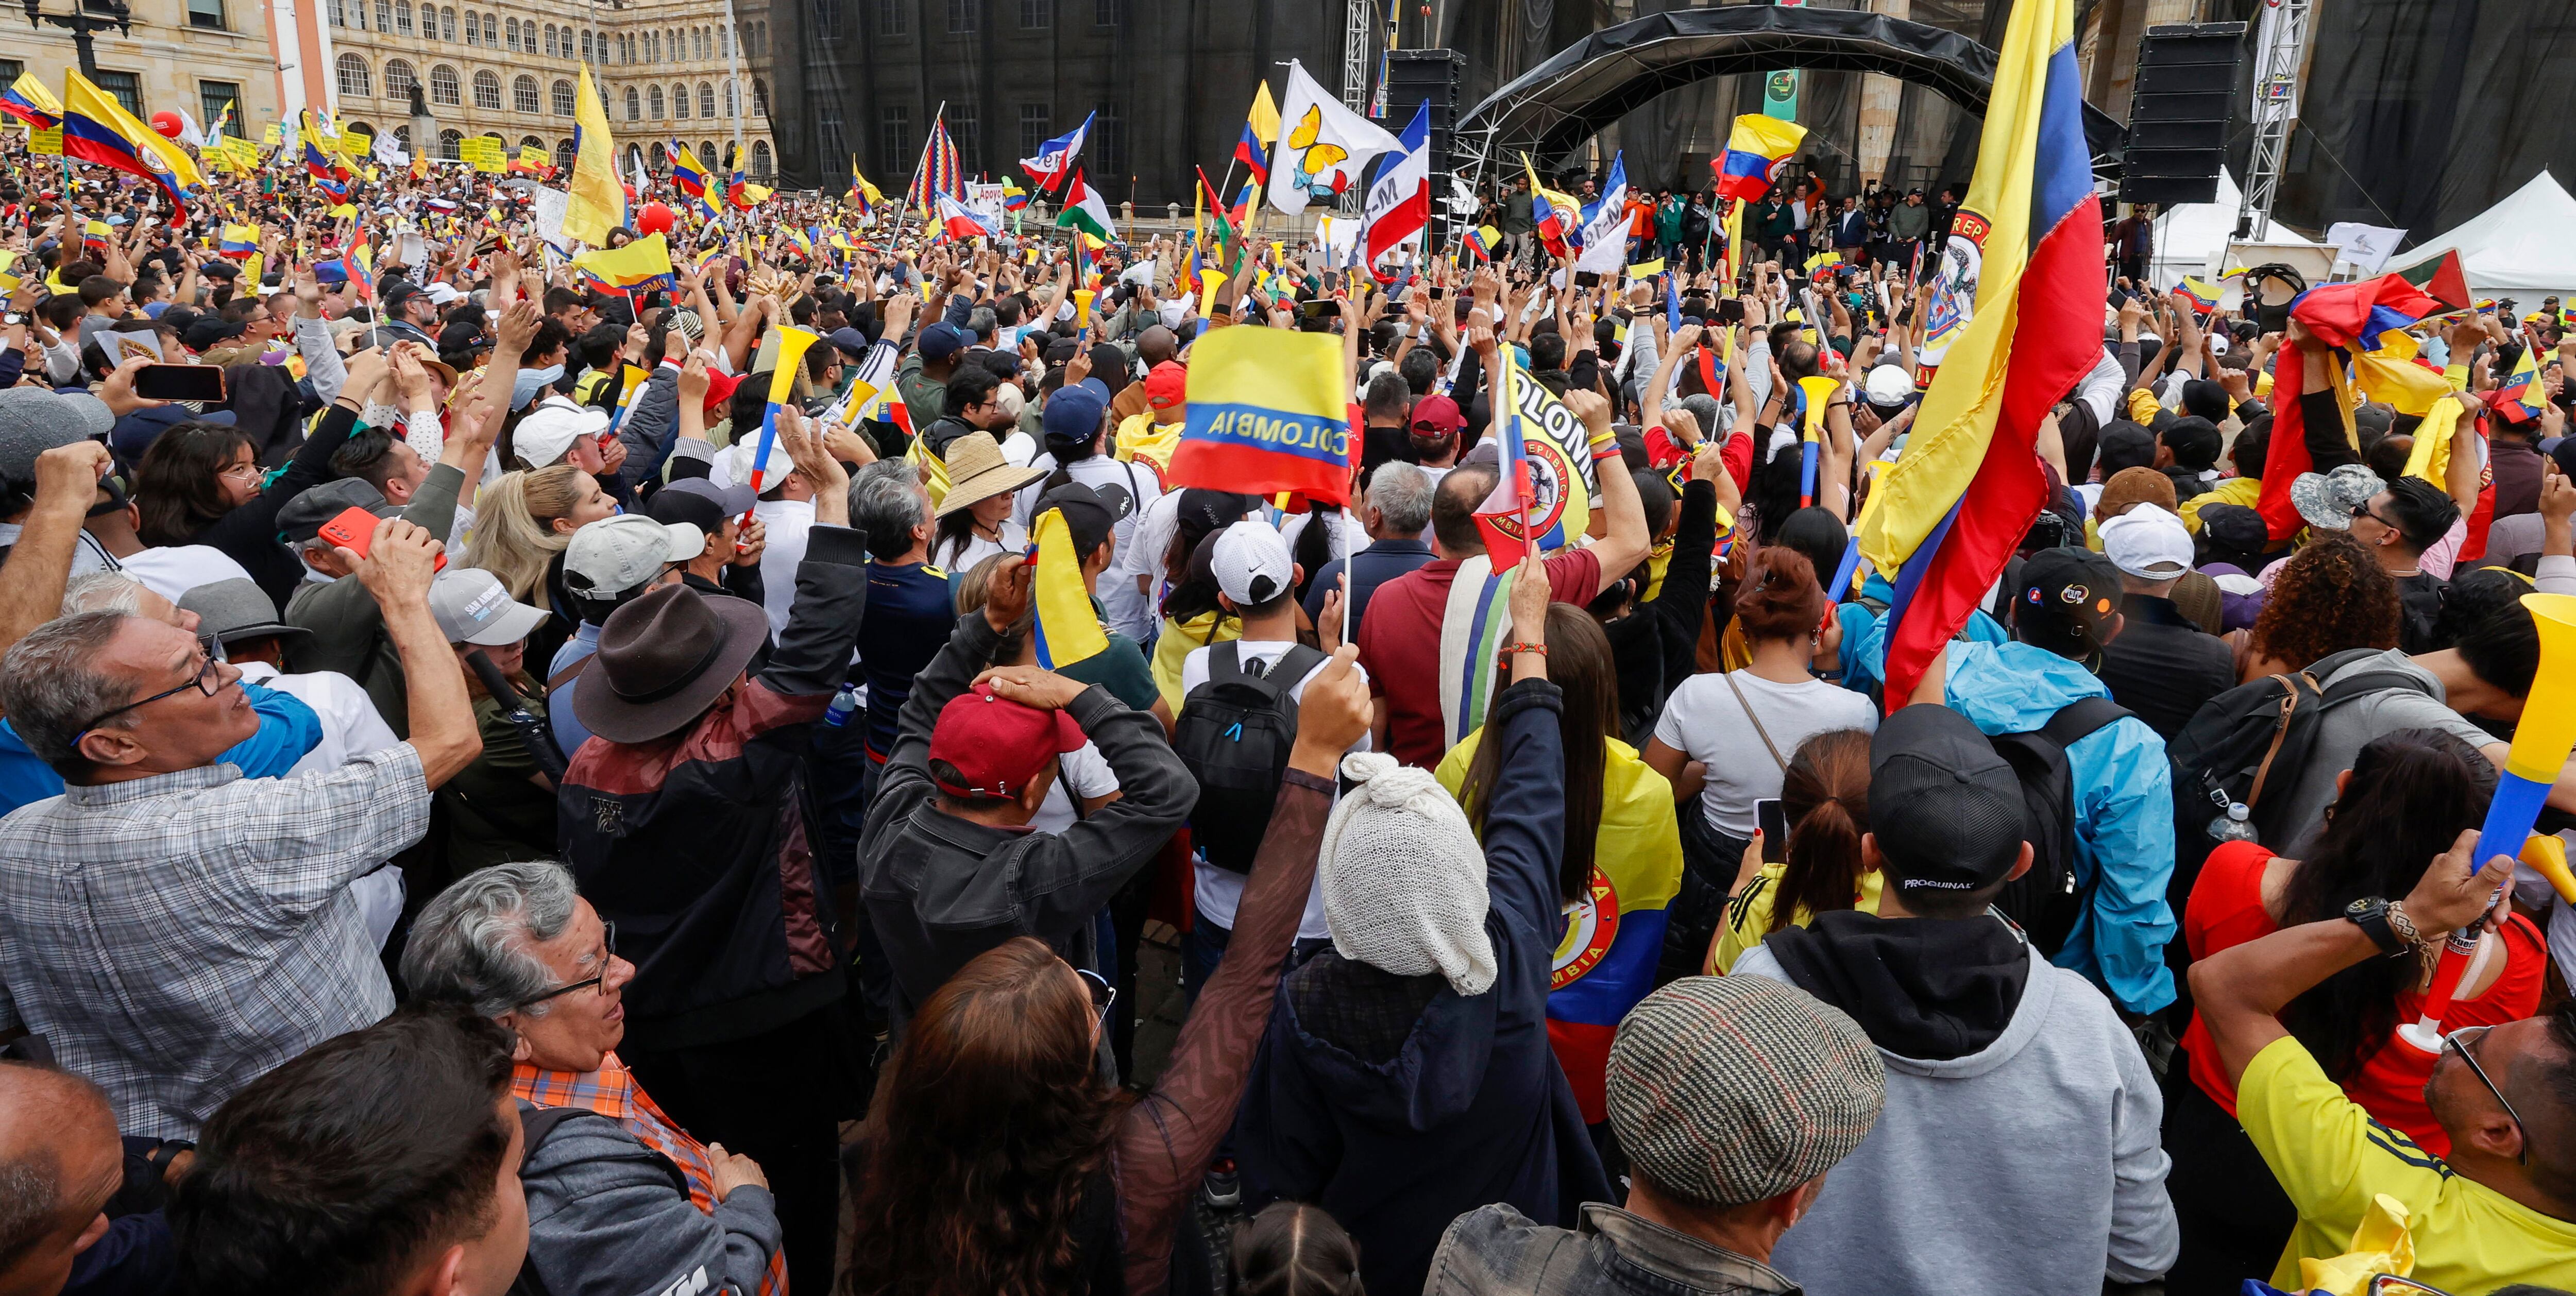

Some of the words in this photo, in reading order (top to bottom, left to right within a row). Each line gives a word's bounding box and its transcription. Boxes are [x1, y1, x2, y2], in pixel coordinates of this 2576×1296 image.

[979, 187, 1001, 202] Apoyo
[464, 600, 482, 616] SAN
[1905, 879, 1972, 889] PROQUINAL
